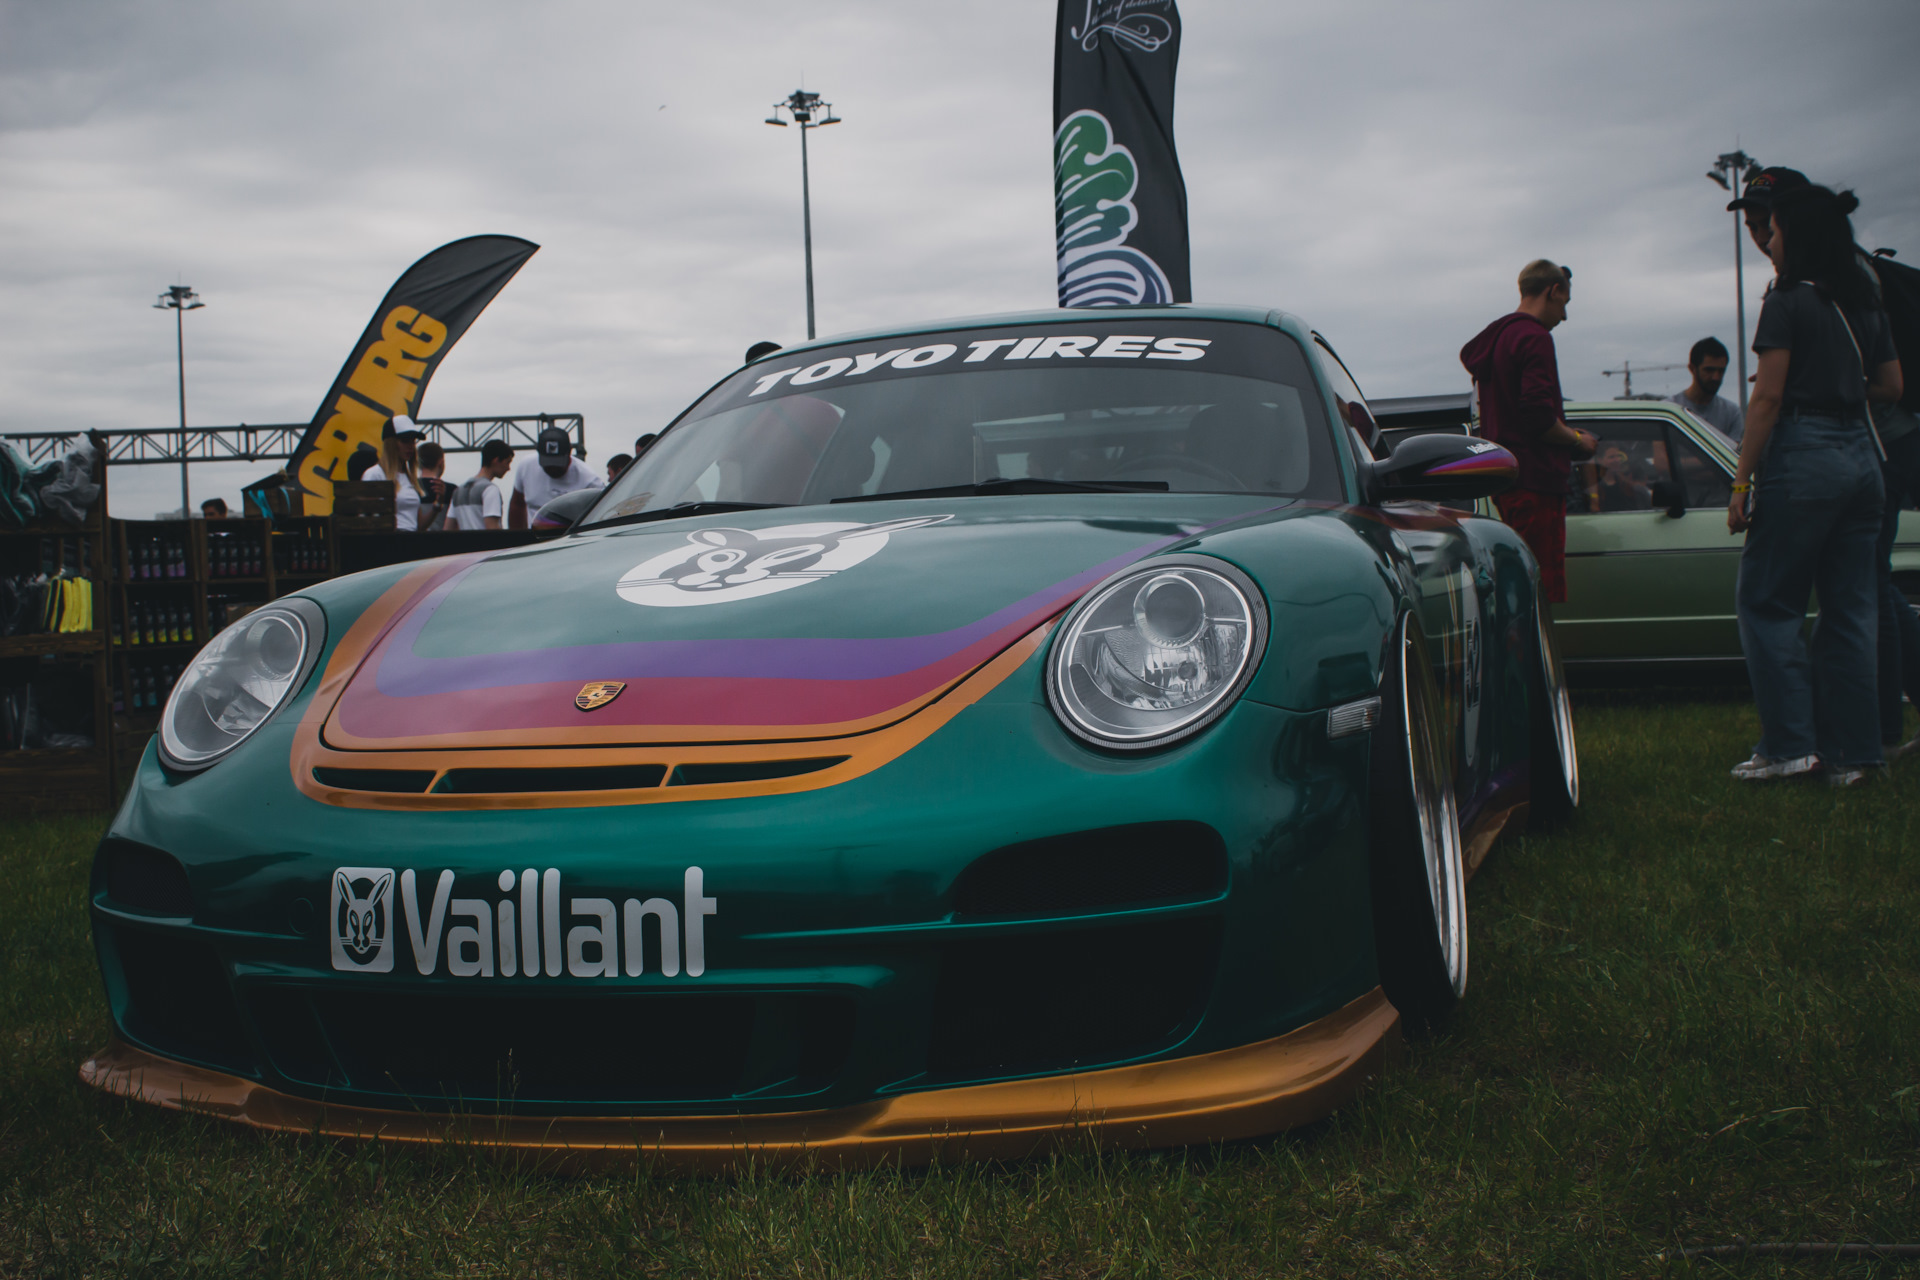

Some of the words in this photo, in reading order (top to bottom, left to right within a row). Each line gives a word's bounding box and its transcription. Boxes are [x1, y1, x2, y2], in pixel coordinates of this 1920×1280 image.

[748, 343, 958, 397] TOYO
[963, 335, 1212, 361] TIRES
[401, 866, 717, 977] Vaillant
